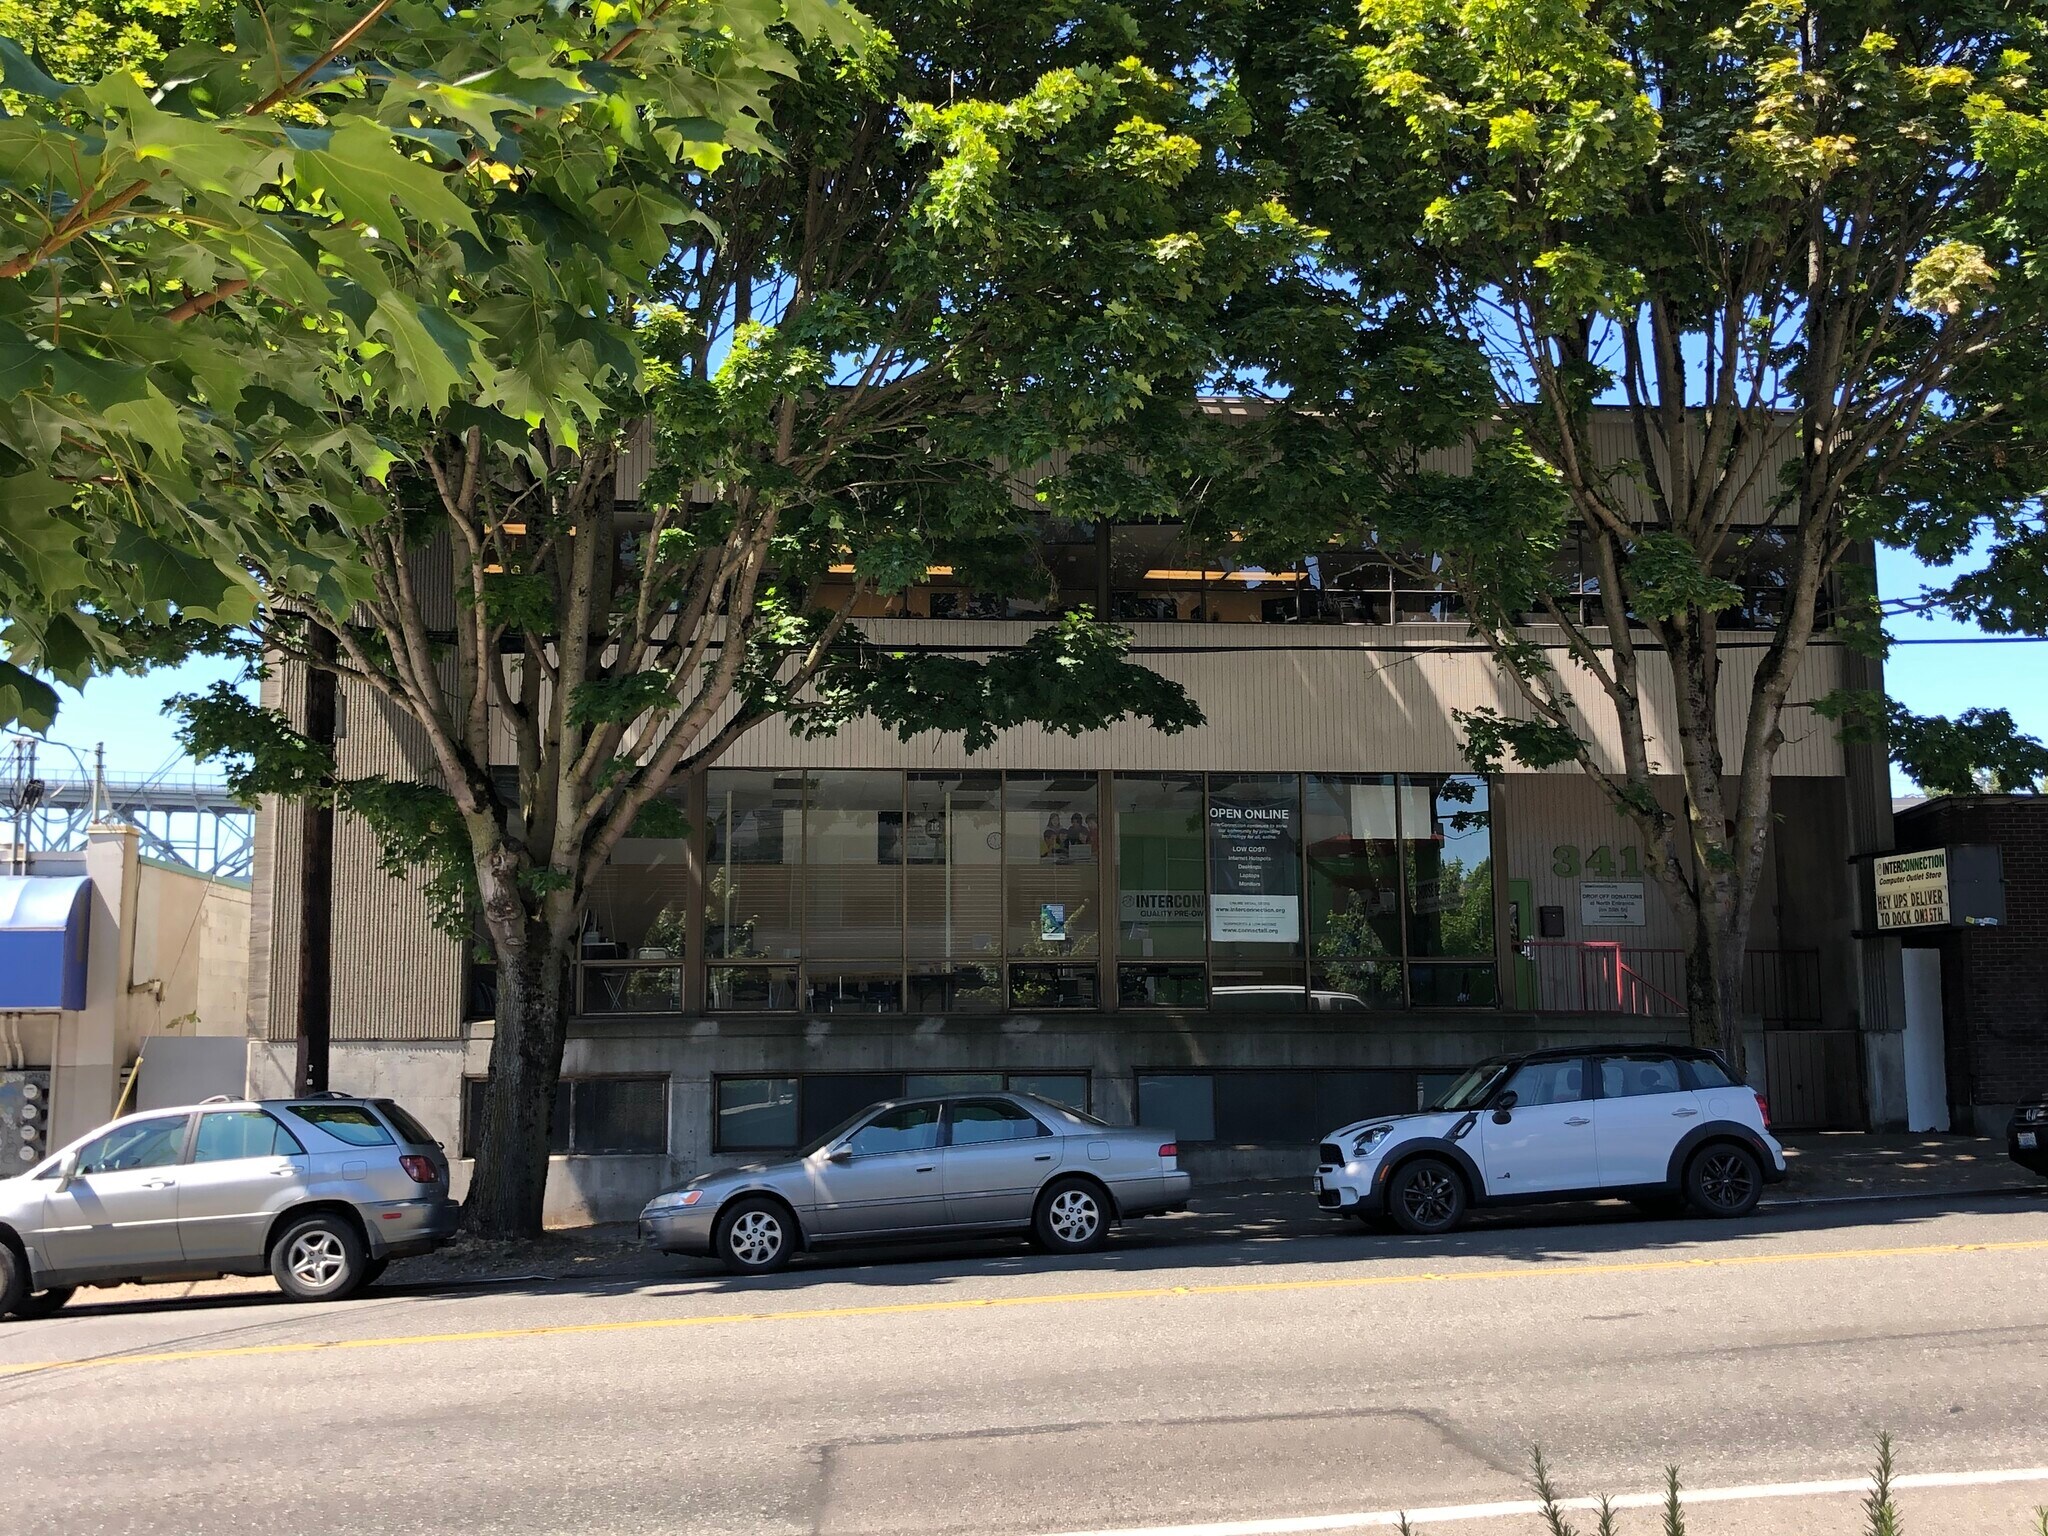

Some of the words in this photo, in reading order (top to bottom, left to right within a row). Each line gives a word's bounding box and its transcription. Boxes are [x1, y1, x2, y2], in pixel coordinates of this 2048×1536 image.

[1210, 807, 1241, 819] OPEN
[1245, 809, 1289, 819] ONLINE
[1553, 845, 1643, 877] 341
[1883, 854, 1944, 875] INTERCONNECTION
[1880, 876, 1905, 886] Computer
[1906, 873, 1924, 881] Outlet
[1136, 895, 1204, 908] INTERCON
[1878, 896, 1890, 910] HEY
[1894, 893, 1907, 908] UPS
[1911, 890, 1943, 906] DELIVER
[1881, 913, 1890, 925] TO
[1892, 910, 1911, 925] DOCK
